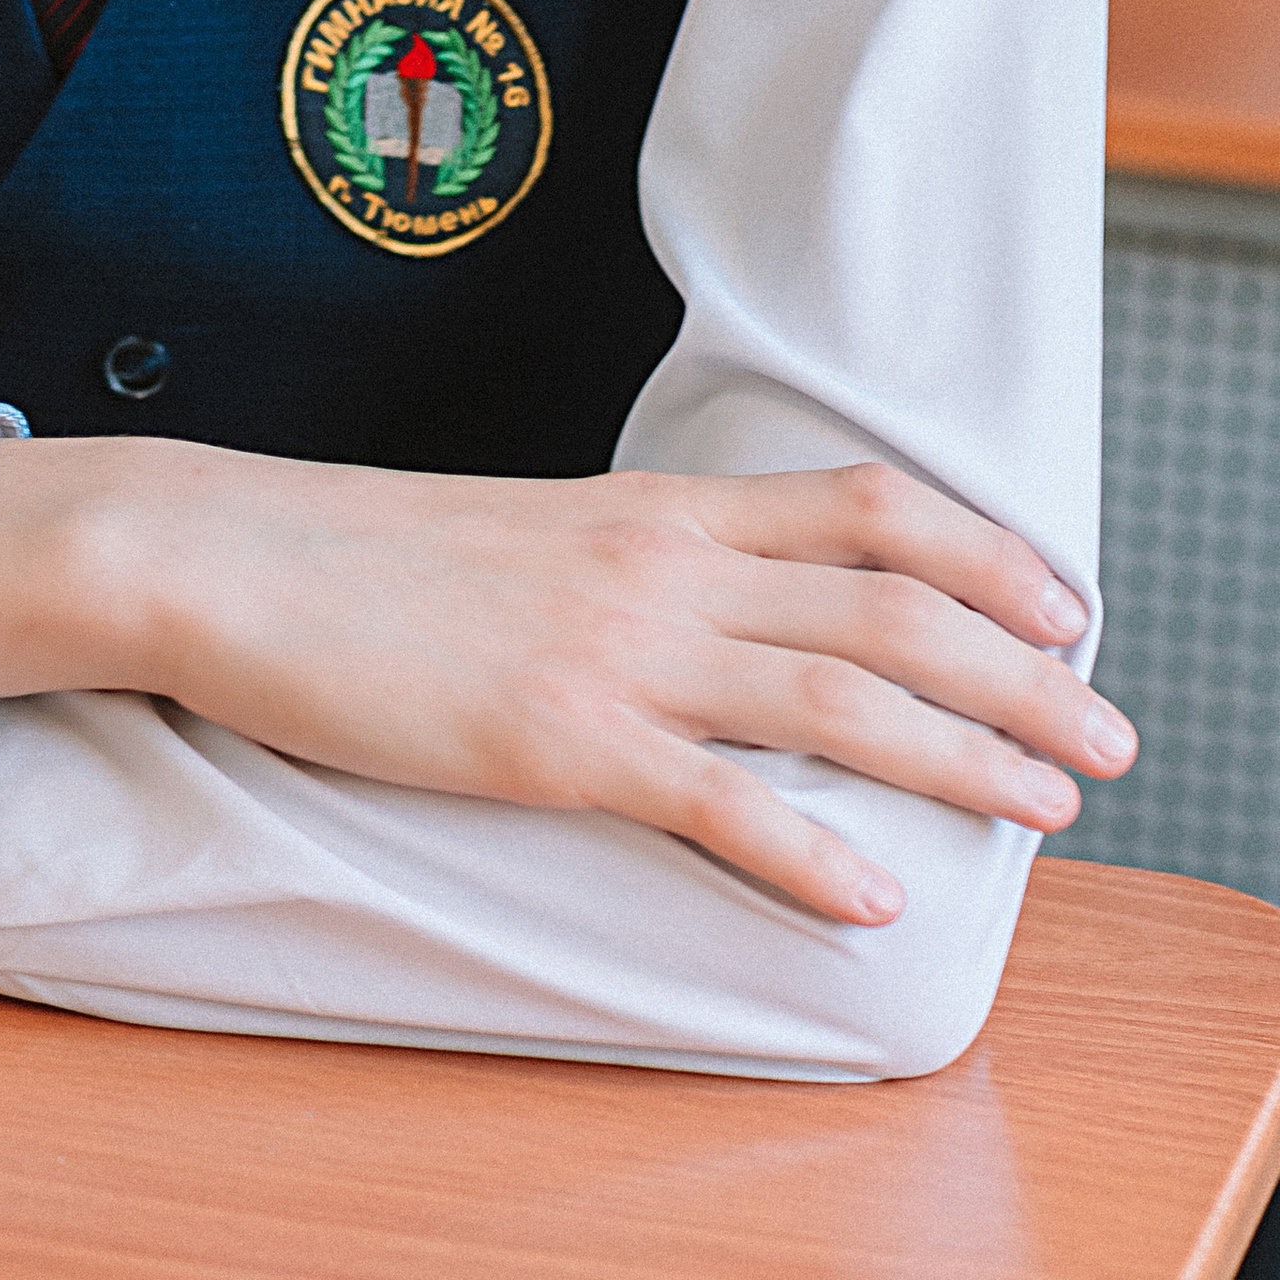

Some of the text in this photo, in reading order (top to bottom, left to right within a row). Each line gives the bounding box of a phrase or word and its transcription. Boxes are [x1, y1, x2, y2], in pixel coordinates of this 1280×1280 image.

[466, 10, 506, 56] №
[497, 62, 531, 108] 16
[363, 192, 499, 236] Тюмень
